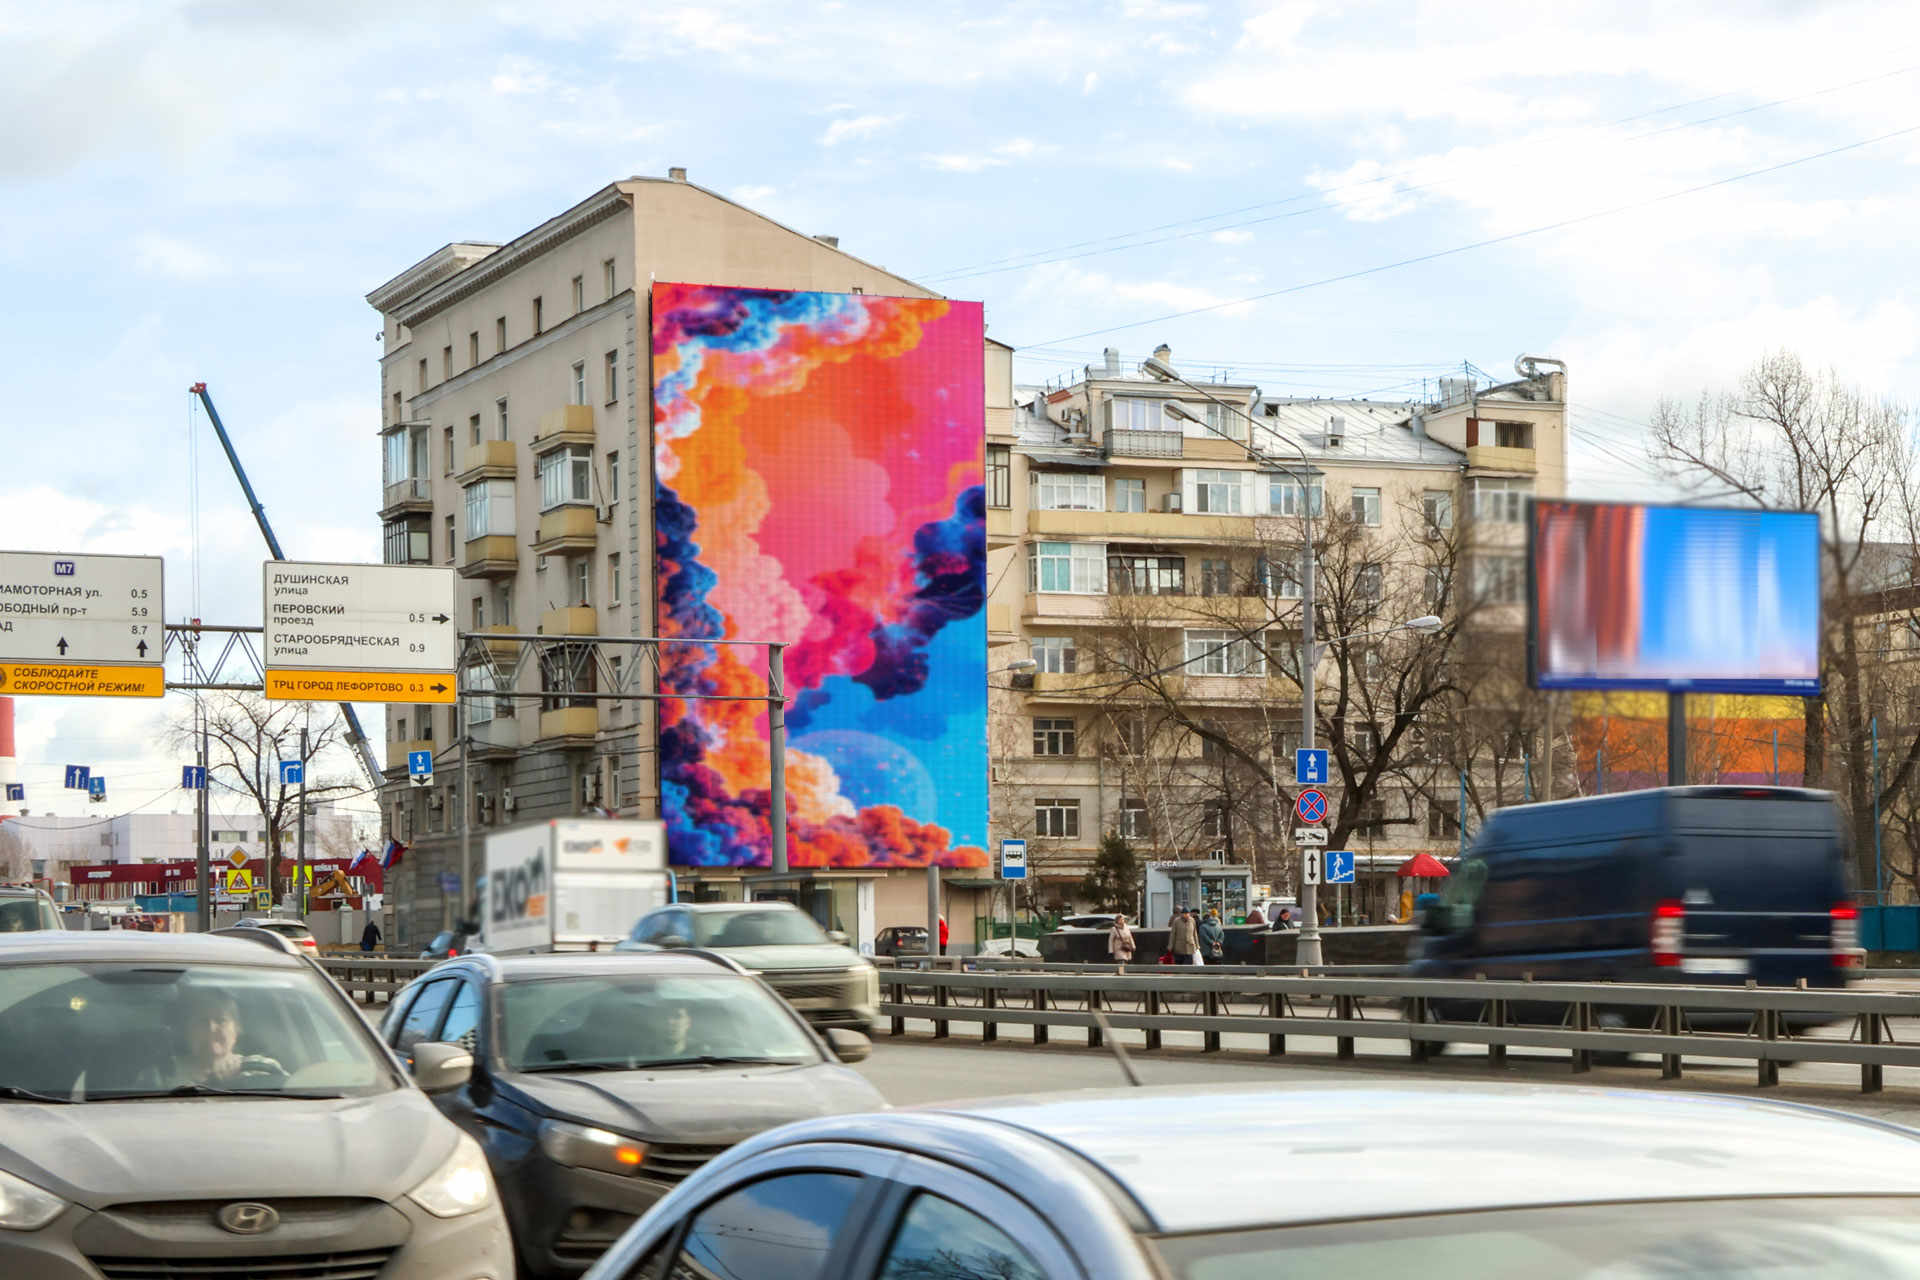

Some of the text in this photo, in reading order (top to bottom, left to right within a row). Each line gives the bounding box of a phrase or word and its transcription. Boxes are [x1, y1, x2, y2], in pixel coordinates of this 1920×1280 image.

[56, 563, 73, 574] М7
[273, 574, 349, 585] ДУШИНСКАЯ
[85, 588, 103, 599] ул.
[131, 589, 148, 599] 0.5
[273, 586, 308, 596] улица
[62, 607, 88, 617] пр-т
[131, 607, 148, 617] 5.9
[273, 603, 345, 615] ПЕРОВСКИЙ
[273, 613, 425, 626] проезд 0.5
[131, 625, 148, 635] 8.7
[273, 634, 400, 647] СТАРООБРЯДЧЕСКАЯ
[273, 643, 425, 656] улица 0.9
[13, 667, 99, 679] СОБЛЮДАЙТЕ
[13, 680, 145, 693] СКОРОСТНОЙ РЕЖИМ!
[273, 680, 424, 692] ТРЦ ГОРОД ЛЕФОРТОВО 0.3
